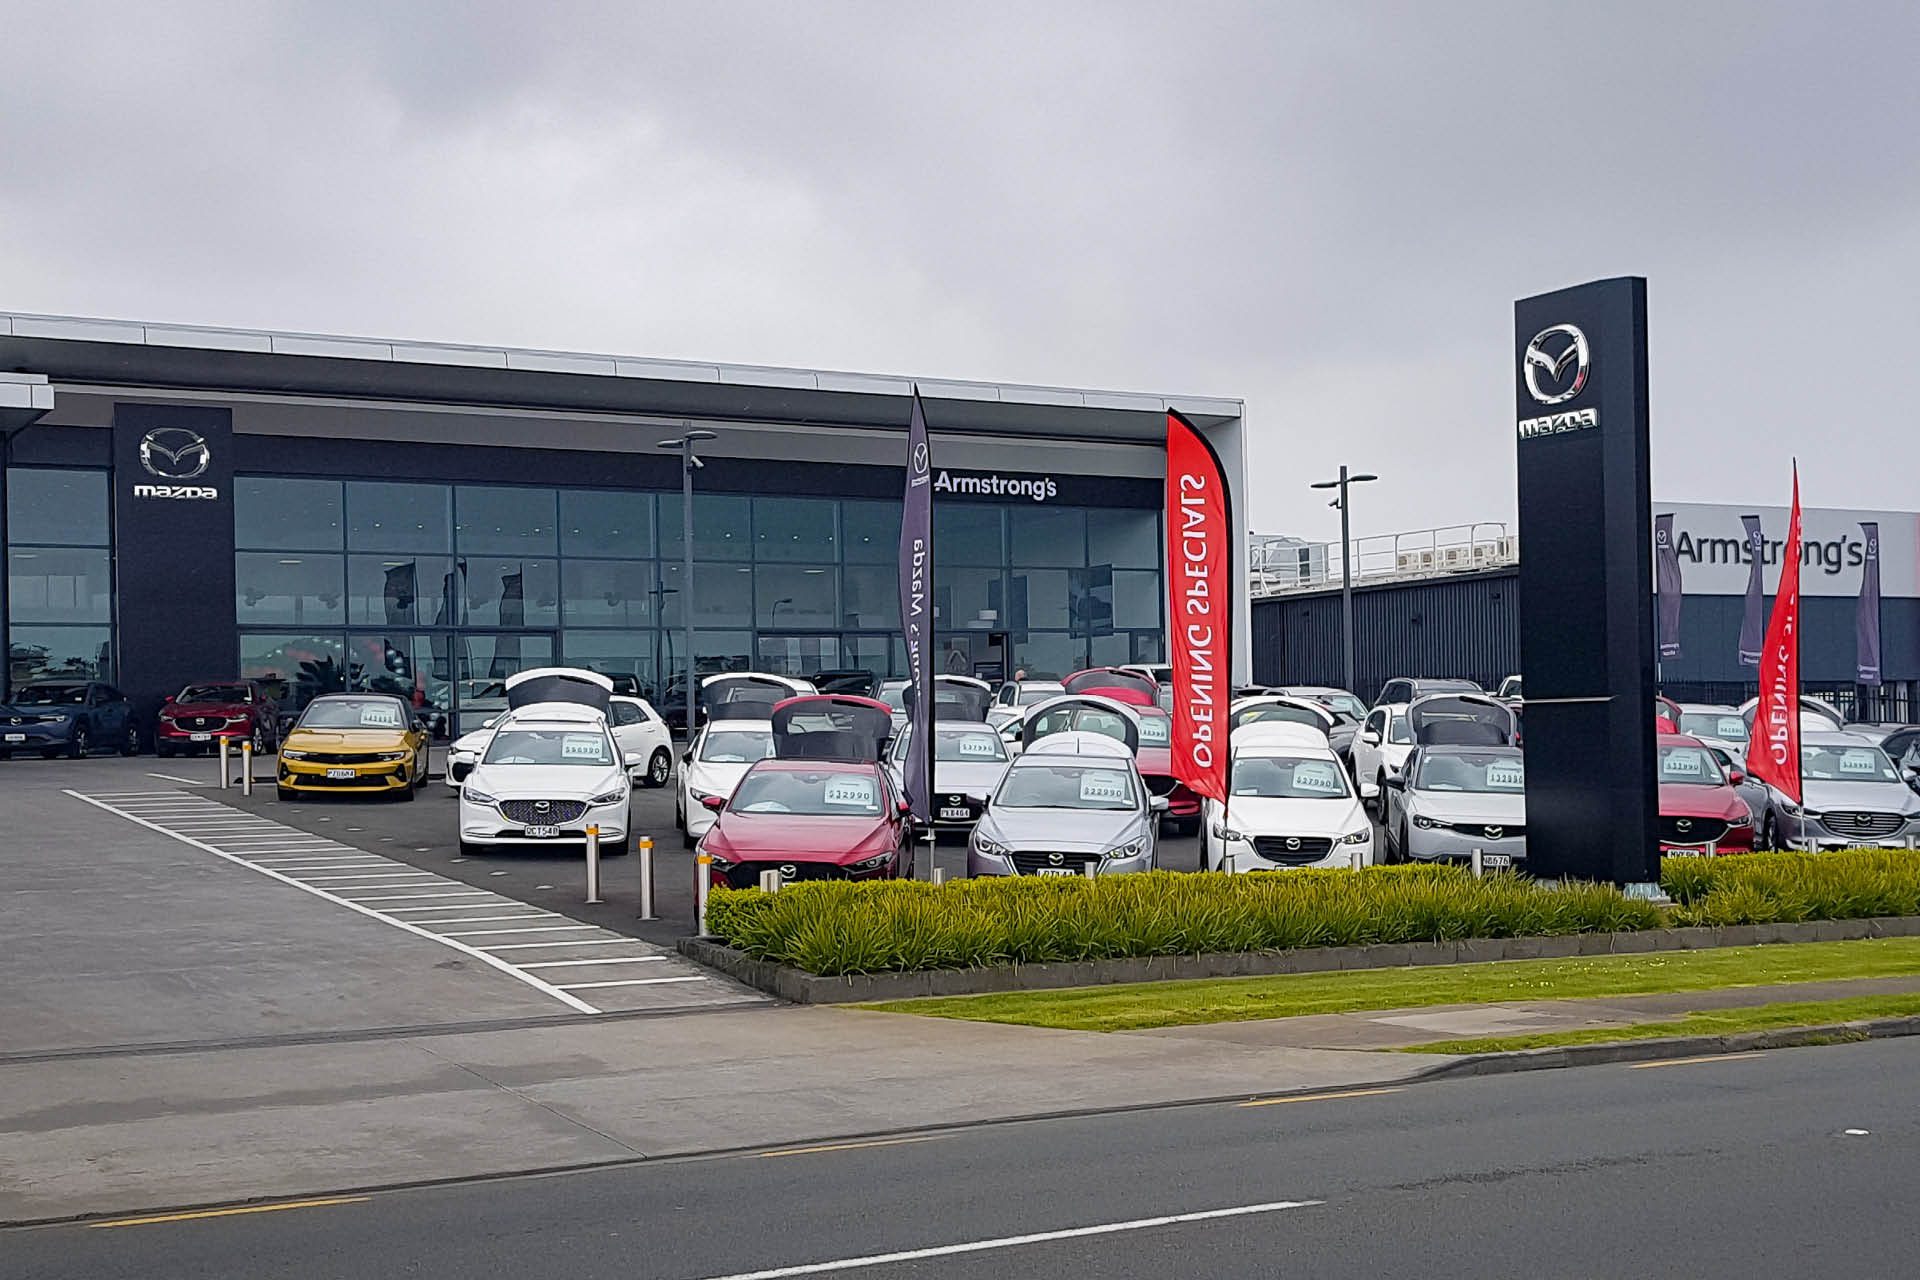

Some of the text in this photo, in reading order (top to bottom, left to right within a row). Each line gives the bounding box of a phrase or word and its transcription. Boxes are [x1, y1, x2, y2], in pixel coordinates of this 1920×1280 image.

[1519, 408, 1598, 440] mazda
[134, 485, 218, 499] mazda
[934, 471, 1057, 501] Armstrong's
